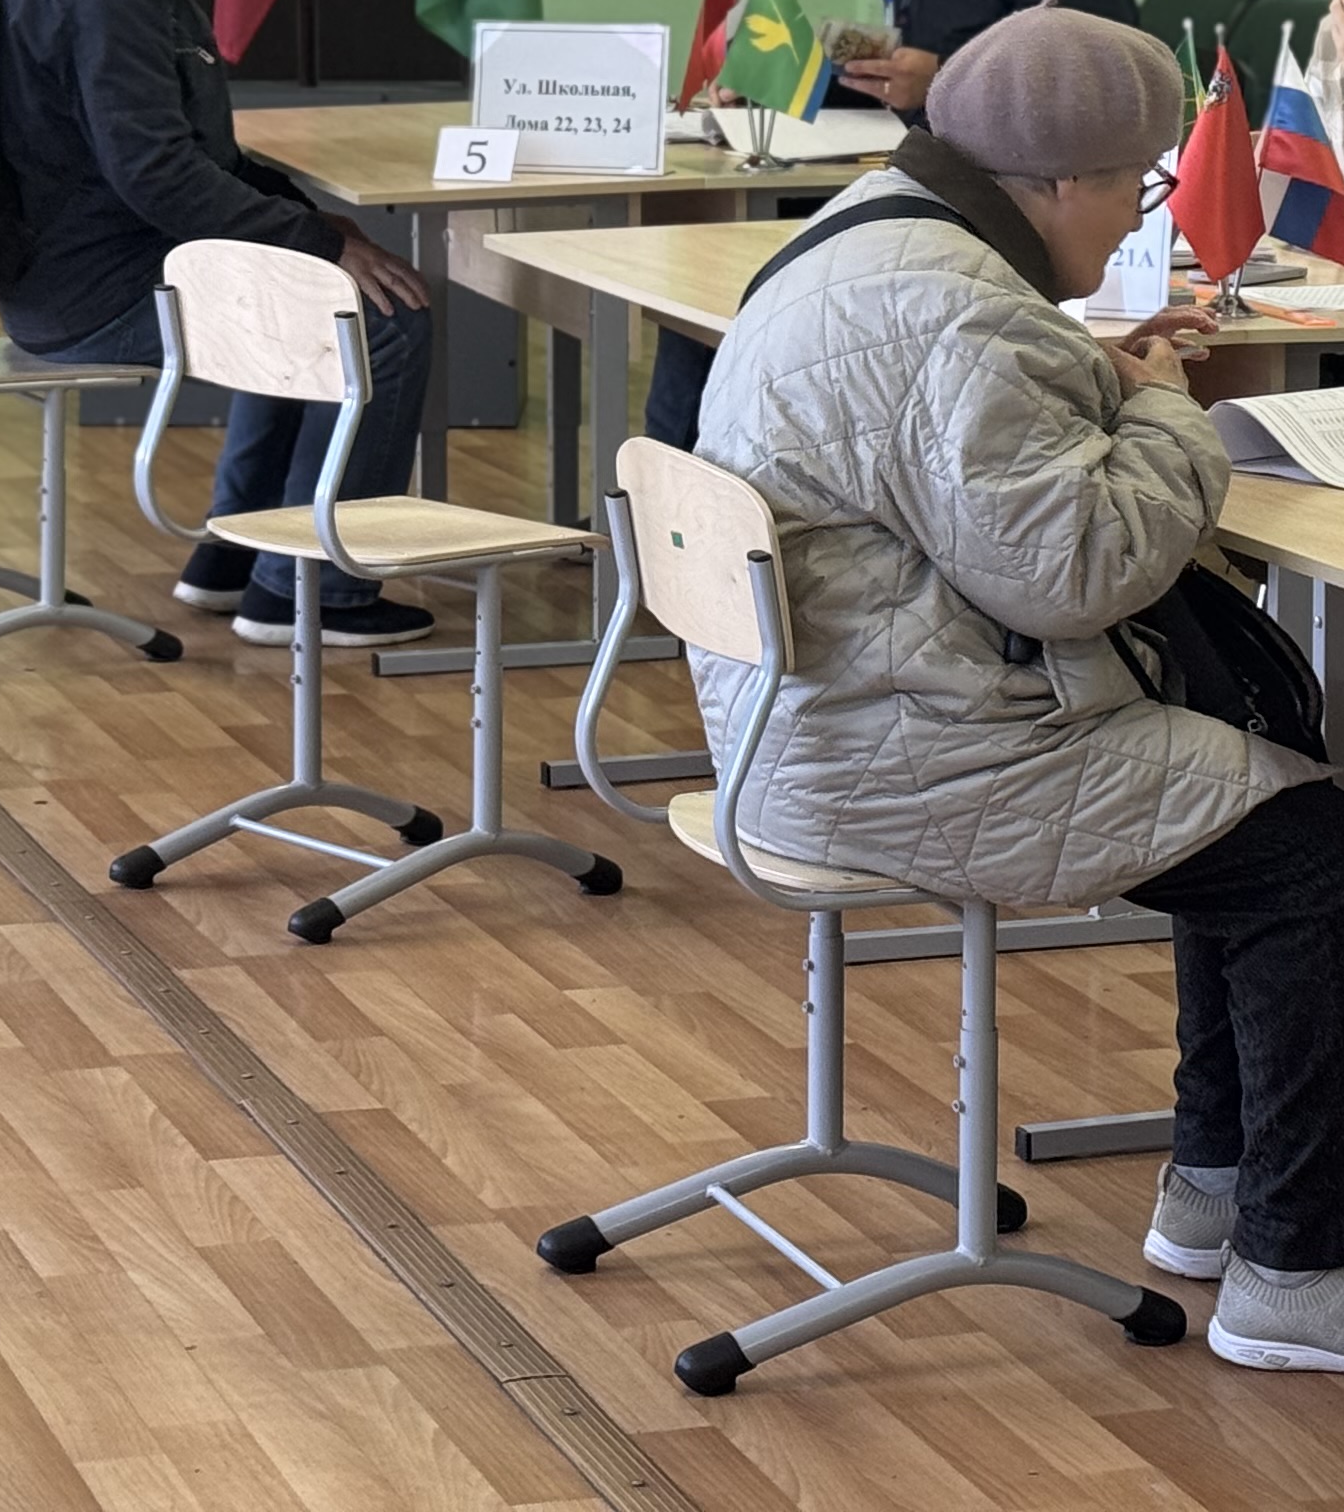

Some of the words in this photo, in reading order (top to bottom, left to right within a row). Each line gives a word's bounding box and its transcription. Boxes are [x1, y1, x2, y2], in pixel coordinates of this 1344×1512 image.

[503, 78, 532, 95] Ул.
[537, 79, 637, 100] Школьная,
[554, 115, 579, 135] 22,
[582, 116, 608, 136] 23,
[612, 117, 632, 134] 24
[462, 140, 489, 175] 5
